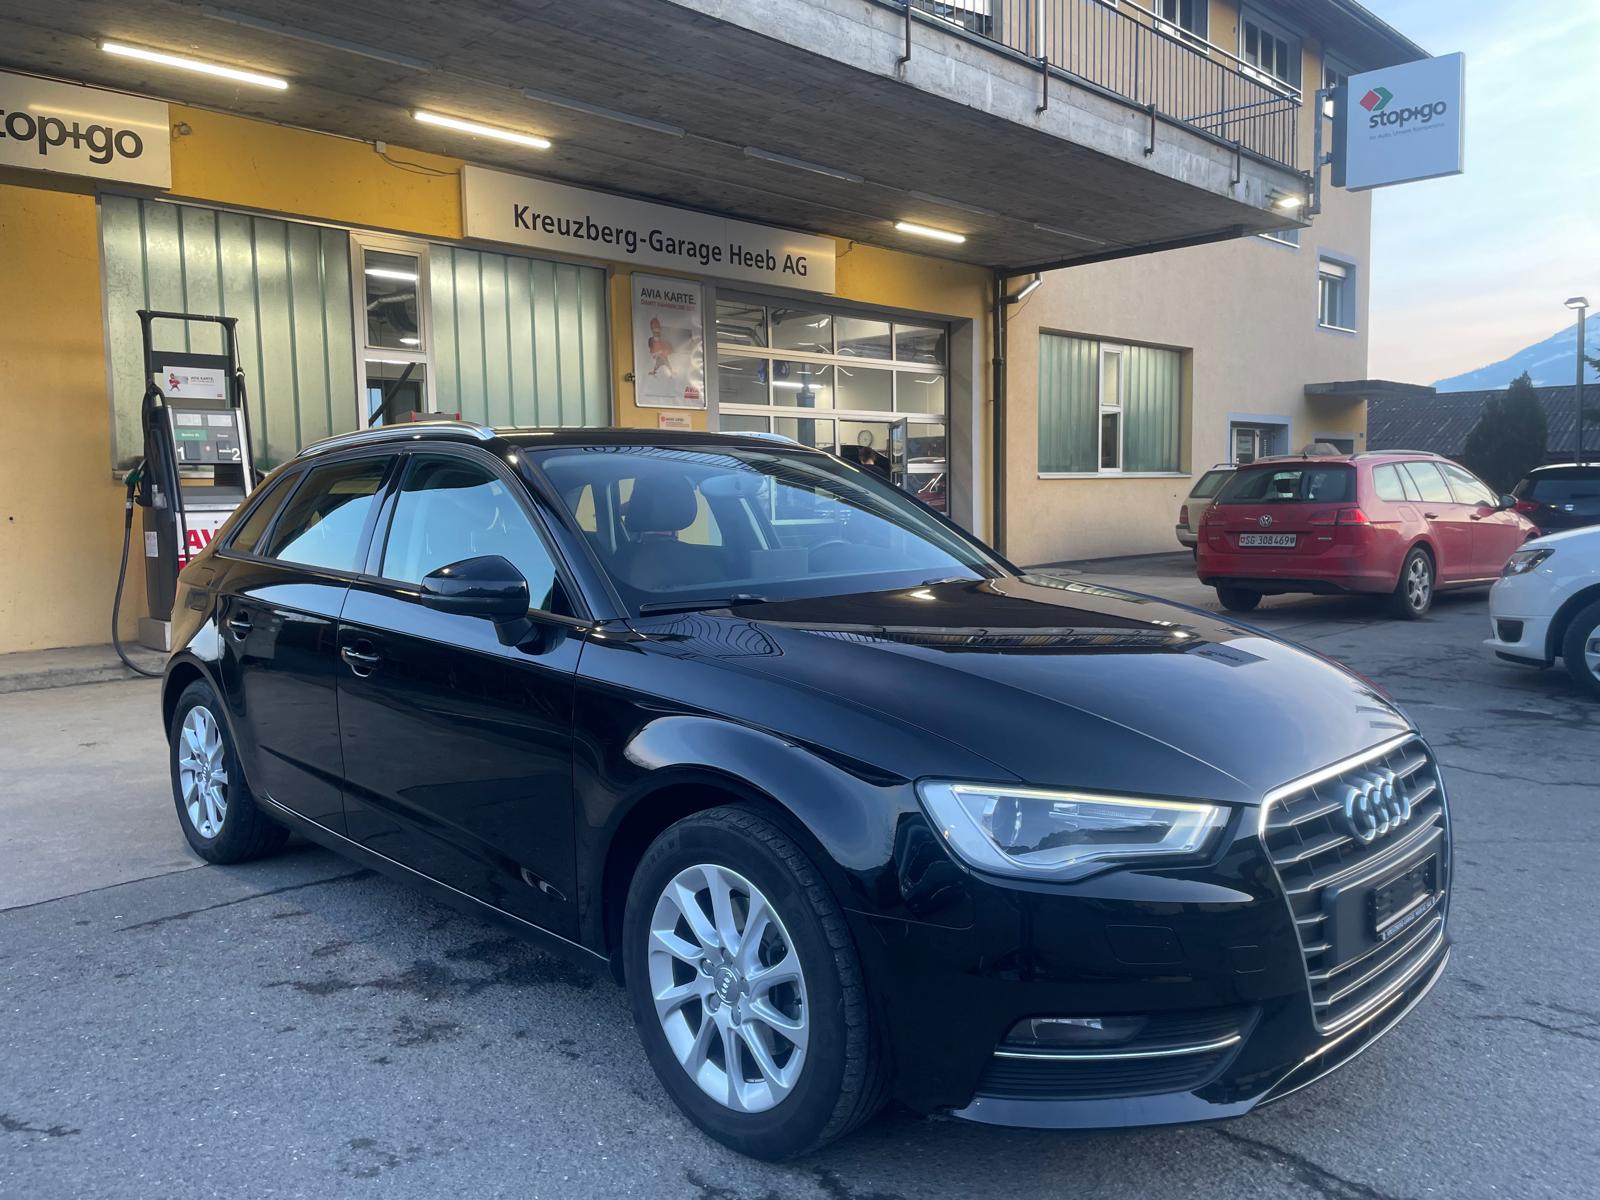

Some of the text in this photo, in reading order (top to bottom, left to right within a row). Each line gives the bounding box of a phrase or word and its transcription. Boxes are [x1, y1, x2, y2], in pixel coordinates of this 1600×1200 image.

[1369, 101, 1447, 129] stop+go
[513, 203, 808, 277] Kreuzberg-Garage Heeb AG
[640, 287, 662, 300] AVIA
[177, 446, 185, 460] 1
[231, 447, 242, 461] 2
[182, 528, 221, 549] AV
